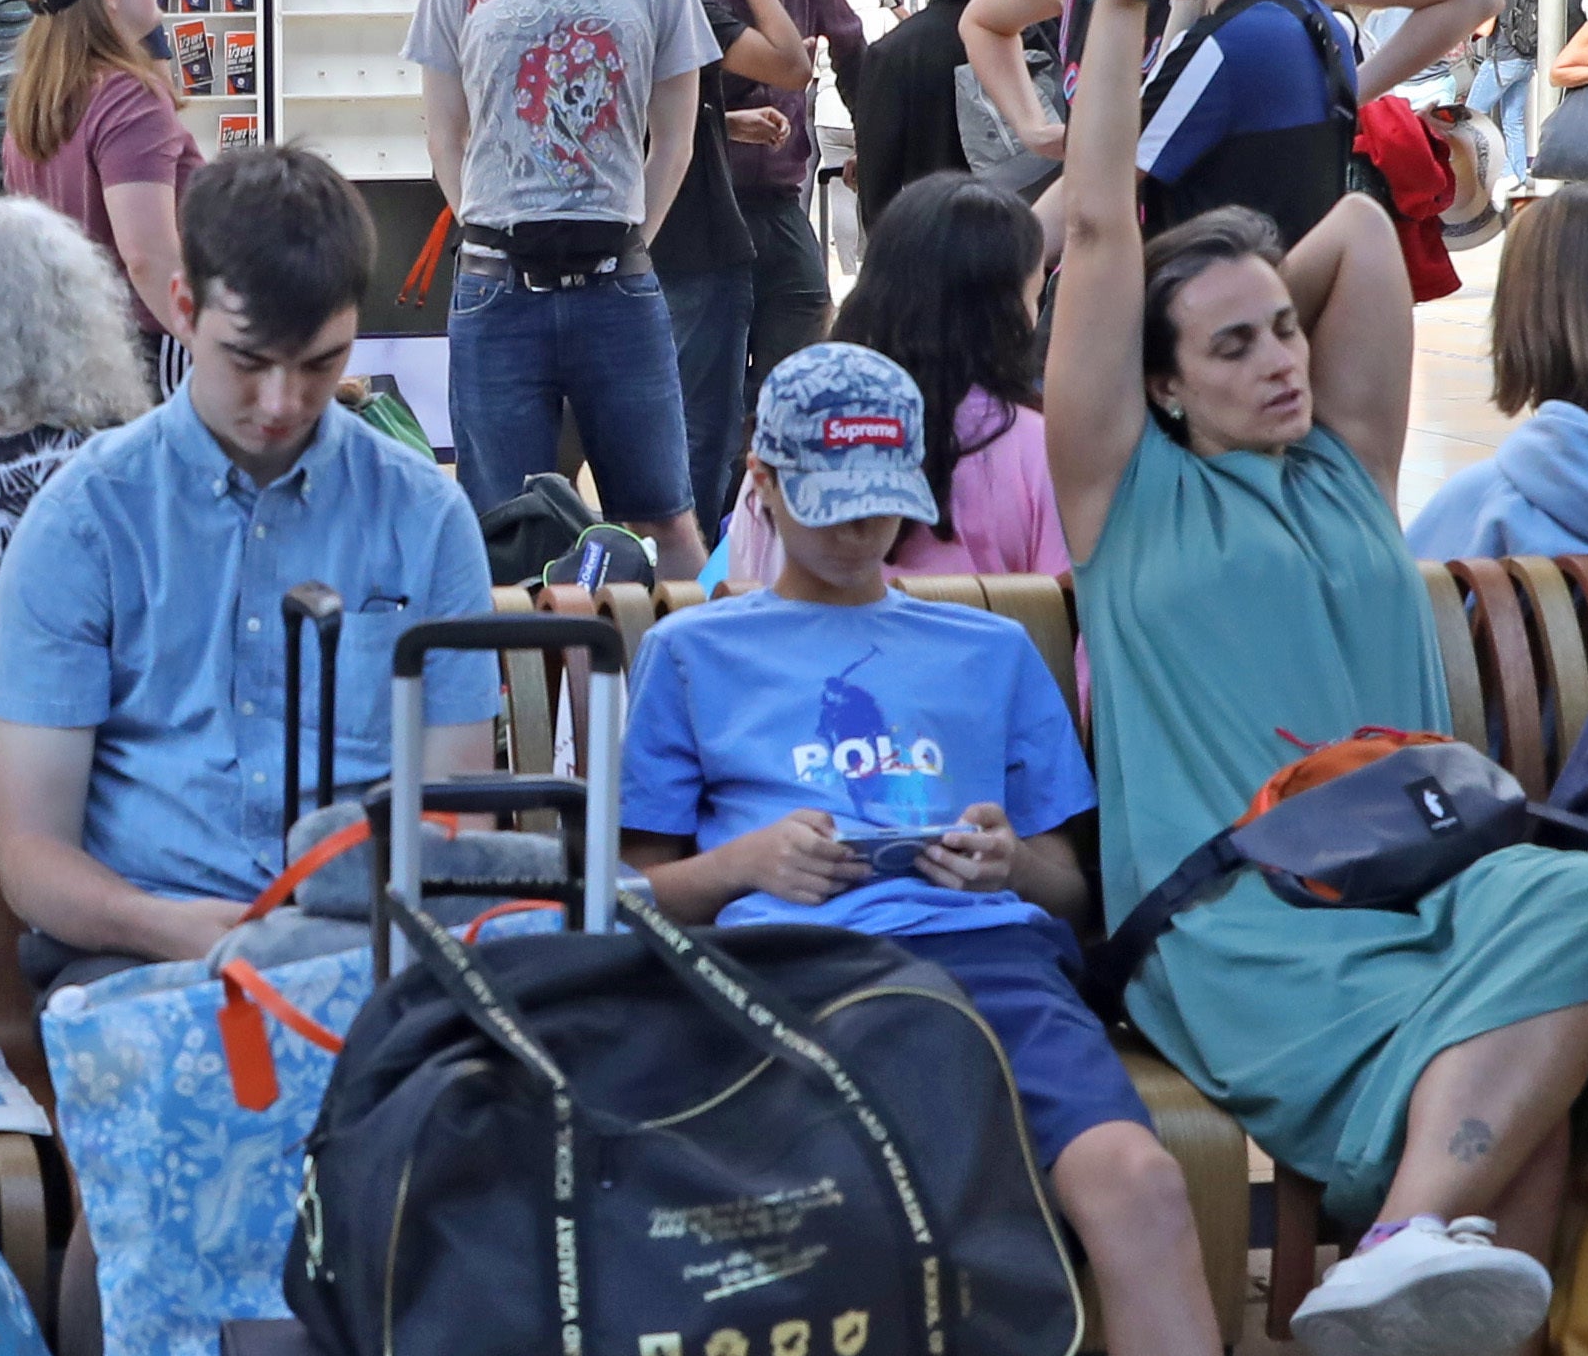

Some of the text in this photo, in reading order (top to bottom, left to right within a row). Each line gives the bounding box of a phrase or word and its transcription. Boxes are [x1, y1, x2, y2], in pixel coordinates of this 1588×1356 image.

[828, 419, 898, 444] Supreme
[791, 735, 944, 783] POLO
[694, 955, 750, 1009] SCHOOL
[748, 1002, 775, 1027] OF
[858, 1105, 887, 1142] AND
[881, 1141, 932, 1244] WIZARDRY
[556, 1216, 580, 1322] WIZARDRY
